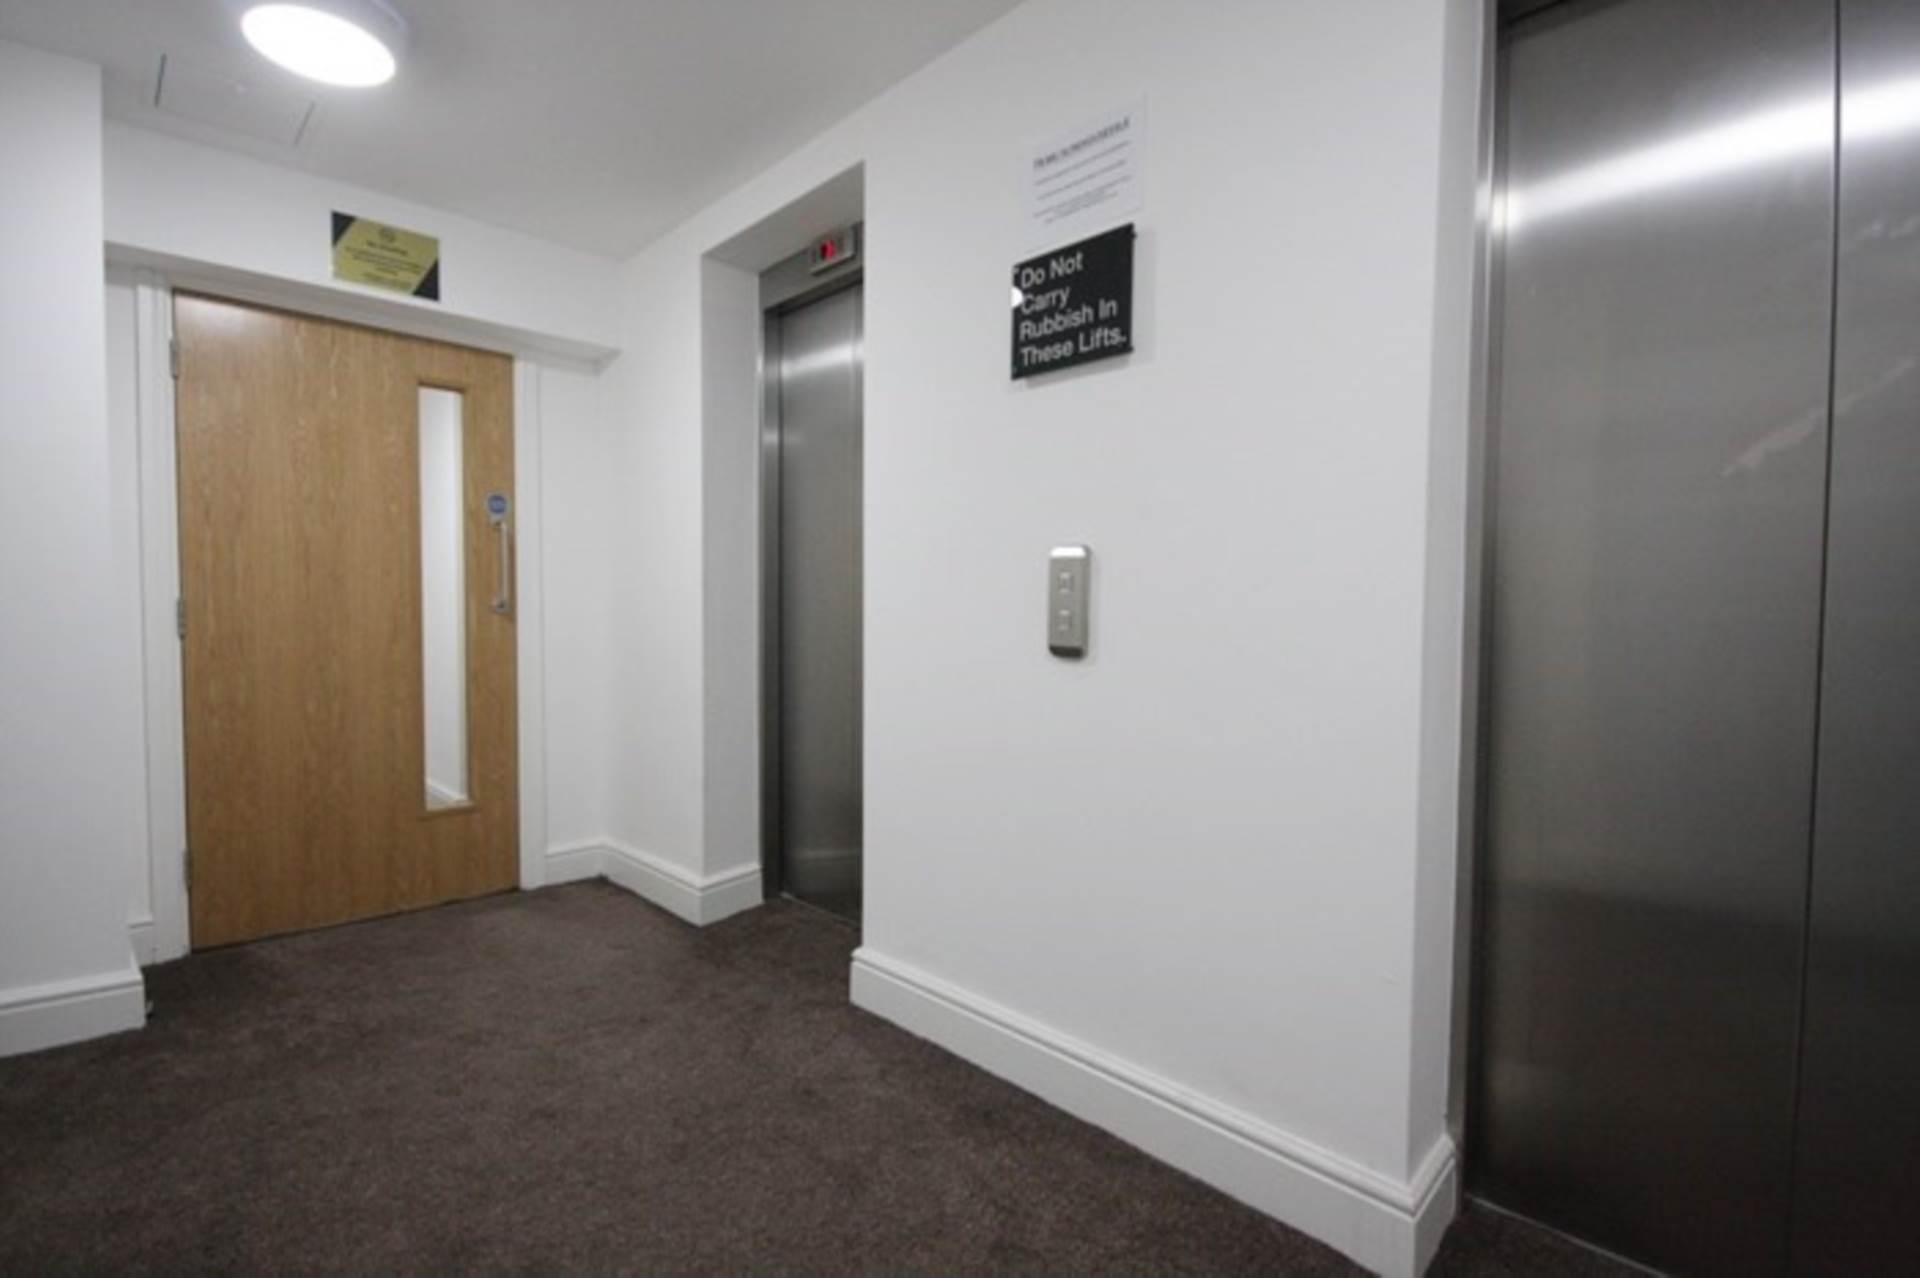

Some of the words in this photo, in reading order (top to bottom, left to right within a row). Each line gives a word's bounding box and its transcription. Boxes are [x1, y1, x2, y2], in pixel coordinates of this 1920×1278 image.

[1021, 267, 1045, 289] Do
[1050, 251, 1083, 279] Not
[1019, 302, 1094, 342] Rubbish
[1099, 298, 1118, 320] In
[1020, 286, 1070, 315] Carry
[1020, 340, 1074, 367] These
[1078, 327, 1127, 353] Lifts.
